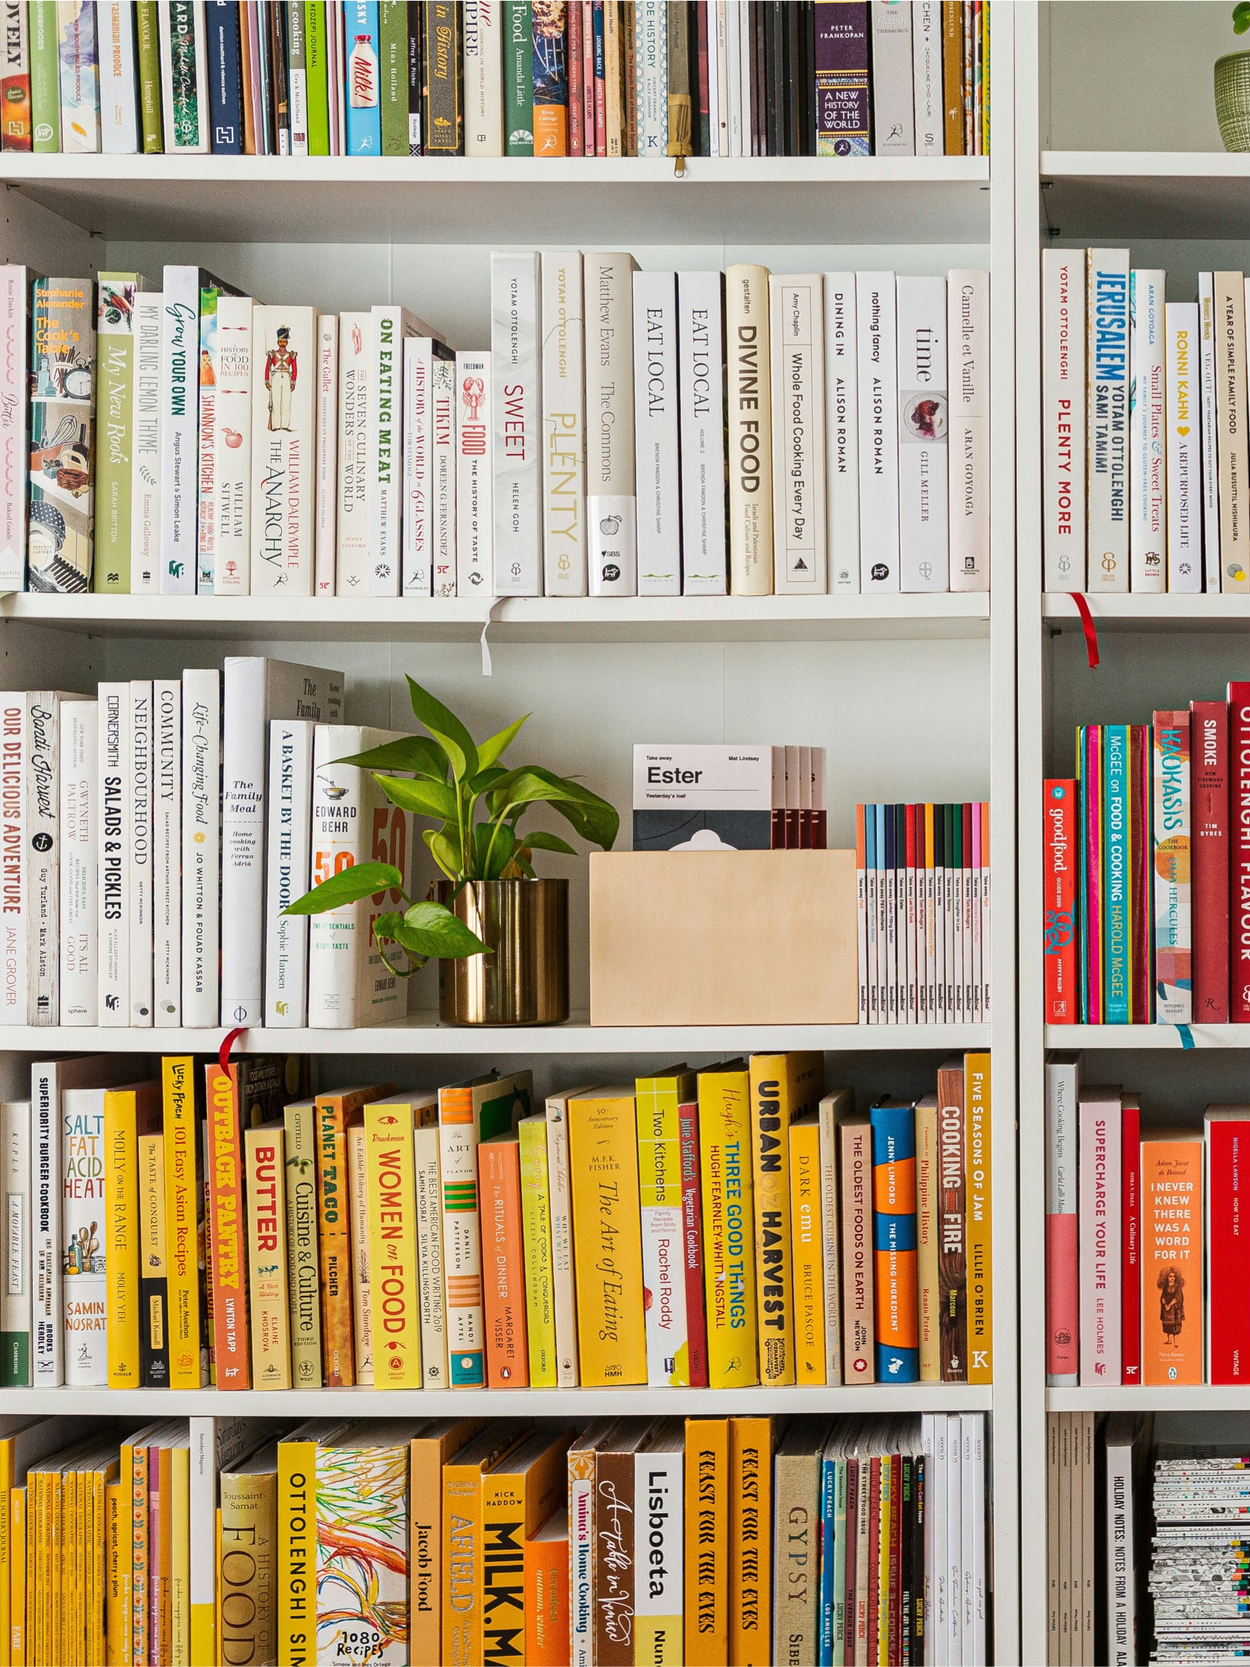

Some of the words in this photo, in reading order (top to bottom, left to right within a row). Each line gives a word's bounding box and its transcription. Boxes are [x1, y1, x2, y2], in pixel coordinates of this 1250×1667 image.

[352, 55, 373, 102] Milk!
[515, 48, 524, 81] Amanda
[515, 84, 524, 106] Little
[824, 101, 859, 110] HISTORY
[824, 110, 837, 119] OF
[841, 110, 860, 119] THE
[825, 92, 832, 100] A
[836, 92, 859, 100] NEW
[824, 120, 860, 128] WORLD
[37, 289, 83, 299] Stephanie
[37, 300, 84, 310] Alexander
[380, 319, 393, 342] ON
[102, 345, 127, 374] My
[738, 326, 758, 410] DIVINE
[791, 353, 803, 391] Whole
[915, 326, 932, 382] time
[1177, 331, 1188, 378] RONNI
[108, 380, 127, 420] New
[380, 350, 392, 424] EATING
[1177, 382, 1188, 420] KAHN
[436, 396, 449, 445] TIKIM
[504, 385, 525, 461] SWEET
[792, 394, 804, 424] Food
[107, 422, 128, 464] Roots
[379, 431, 392, 484] MEAT
[739, 422, 759, 493] FOOD
[791, 427, 804, 477] Cooking
[1058, 400, 1071, 474] PLENTY
[549, 413, 577, 543] PLENTY
[792, 481, 804, 515] Every
[792, 517, 805, 540] Day
[1058, 481, 1071, 535] MORE
[160, 691, 173, 801] COMMUNITY
[1203, 720, 1217, 766] SMOKE
[135, 698, 146, 865] NEIGHBOURHOOD
[647, 767, 702, 784] Ester
[105, 777, 121, 837] SALADS
[316, 807, 356, 819] EDWARD
[322, 821, 348, 833] BEHR
[105, 857, 121, 920] PICKLES
[65, 1115, 104, 1135] SALT
[69, 1136, 97, 1156] FAT
[67, 1158, 102, 1177] ACID
[725, 1142, 742, 1203] THREE
[1095, 1120, 1105, 1217] SUPERCHARGE
[64, 1179, 104, 1198] HEAT
[255, 1146, 277, 1252] BUTTER
[378, 1150, 403, 1238] WOMEN
[386, 1241, 403, 1259] on
[726, 1209, 743, 1257] GOOD
[1095, 1221, 1105, 1258] YOUR
[728, 1261, 745, 1328] THINGS
[1095, 1263, 1105, 1290] LIFE
[382, 1265, 405, 1333] FOOD
[1113, 1476, 1125, 1509] HOLIDAY
[287, 1472, 306, 1622] OTTOLENGHI
[415, 1521, 432, 1568] Jacob
[648, 1471, 668, 1599] Lisboeta
[789, 1506, 808, 1604] GYPSY
[578, 1543, 589, 1579] Home
[1115, 1546, 1125, 1571] NOTES
[418, 1573, 432, 1611] Food
[1115, 1575, 1126, 1598] FROM
[576, 1582, 590, 1633] Cooking
